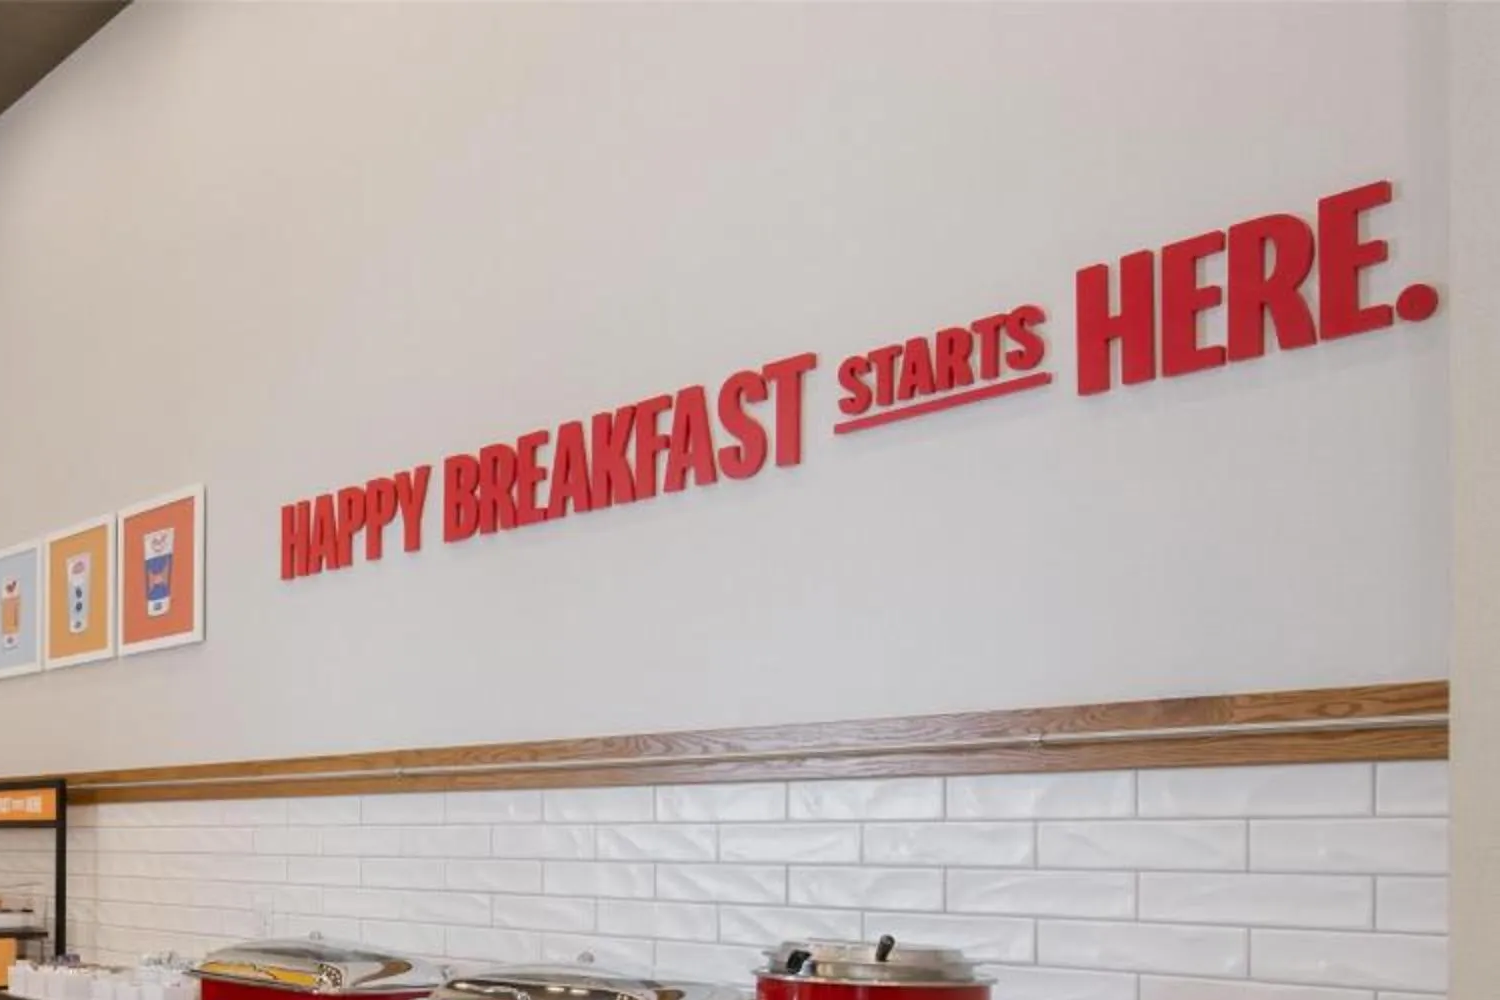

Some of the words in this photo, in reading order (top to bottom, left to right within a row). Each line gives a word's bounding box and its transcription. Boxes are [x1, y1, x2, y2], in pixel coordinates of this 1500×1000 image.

[281, 466, 431, 579] HAPPY
[443, 353, 817, 543] BREAKFAST
[838, 305, 1045, 415] STARTS
[1075, 181, 1440, 395] HERE.
